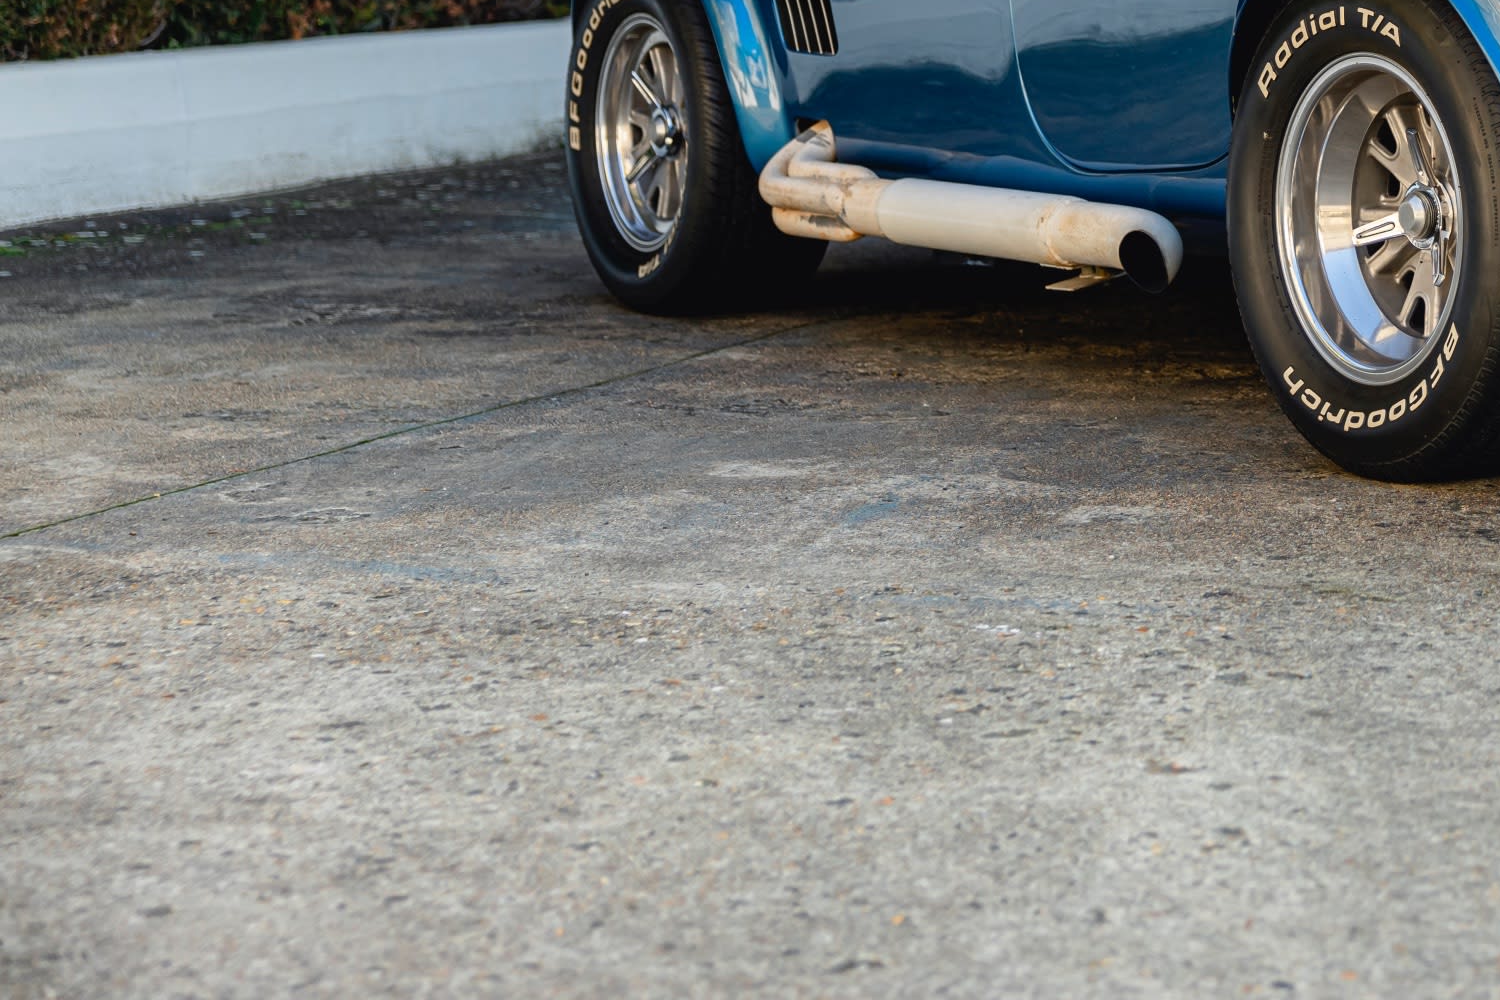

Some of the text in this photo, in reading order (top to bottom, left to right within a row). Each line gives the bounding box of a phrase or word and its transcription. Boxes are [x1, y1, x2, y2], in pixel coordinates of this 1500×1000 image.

[1257, 6, 1401, 98] Radial T/A
[1282, 321, 1462, 432] BFGoodrich
